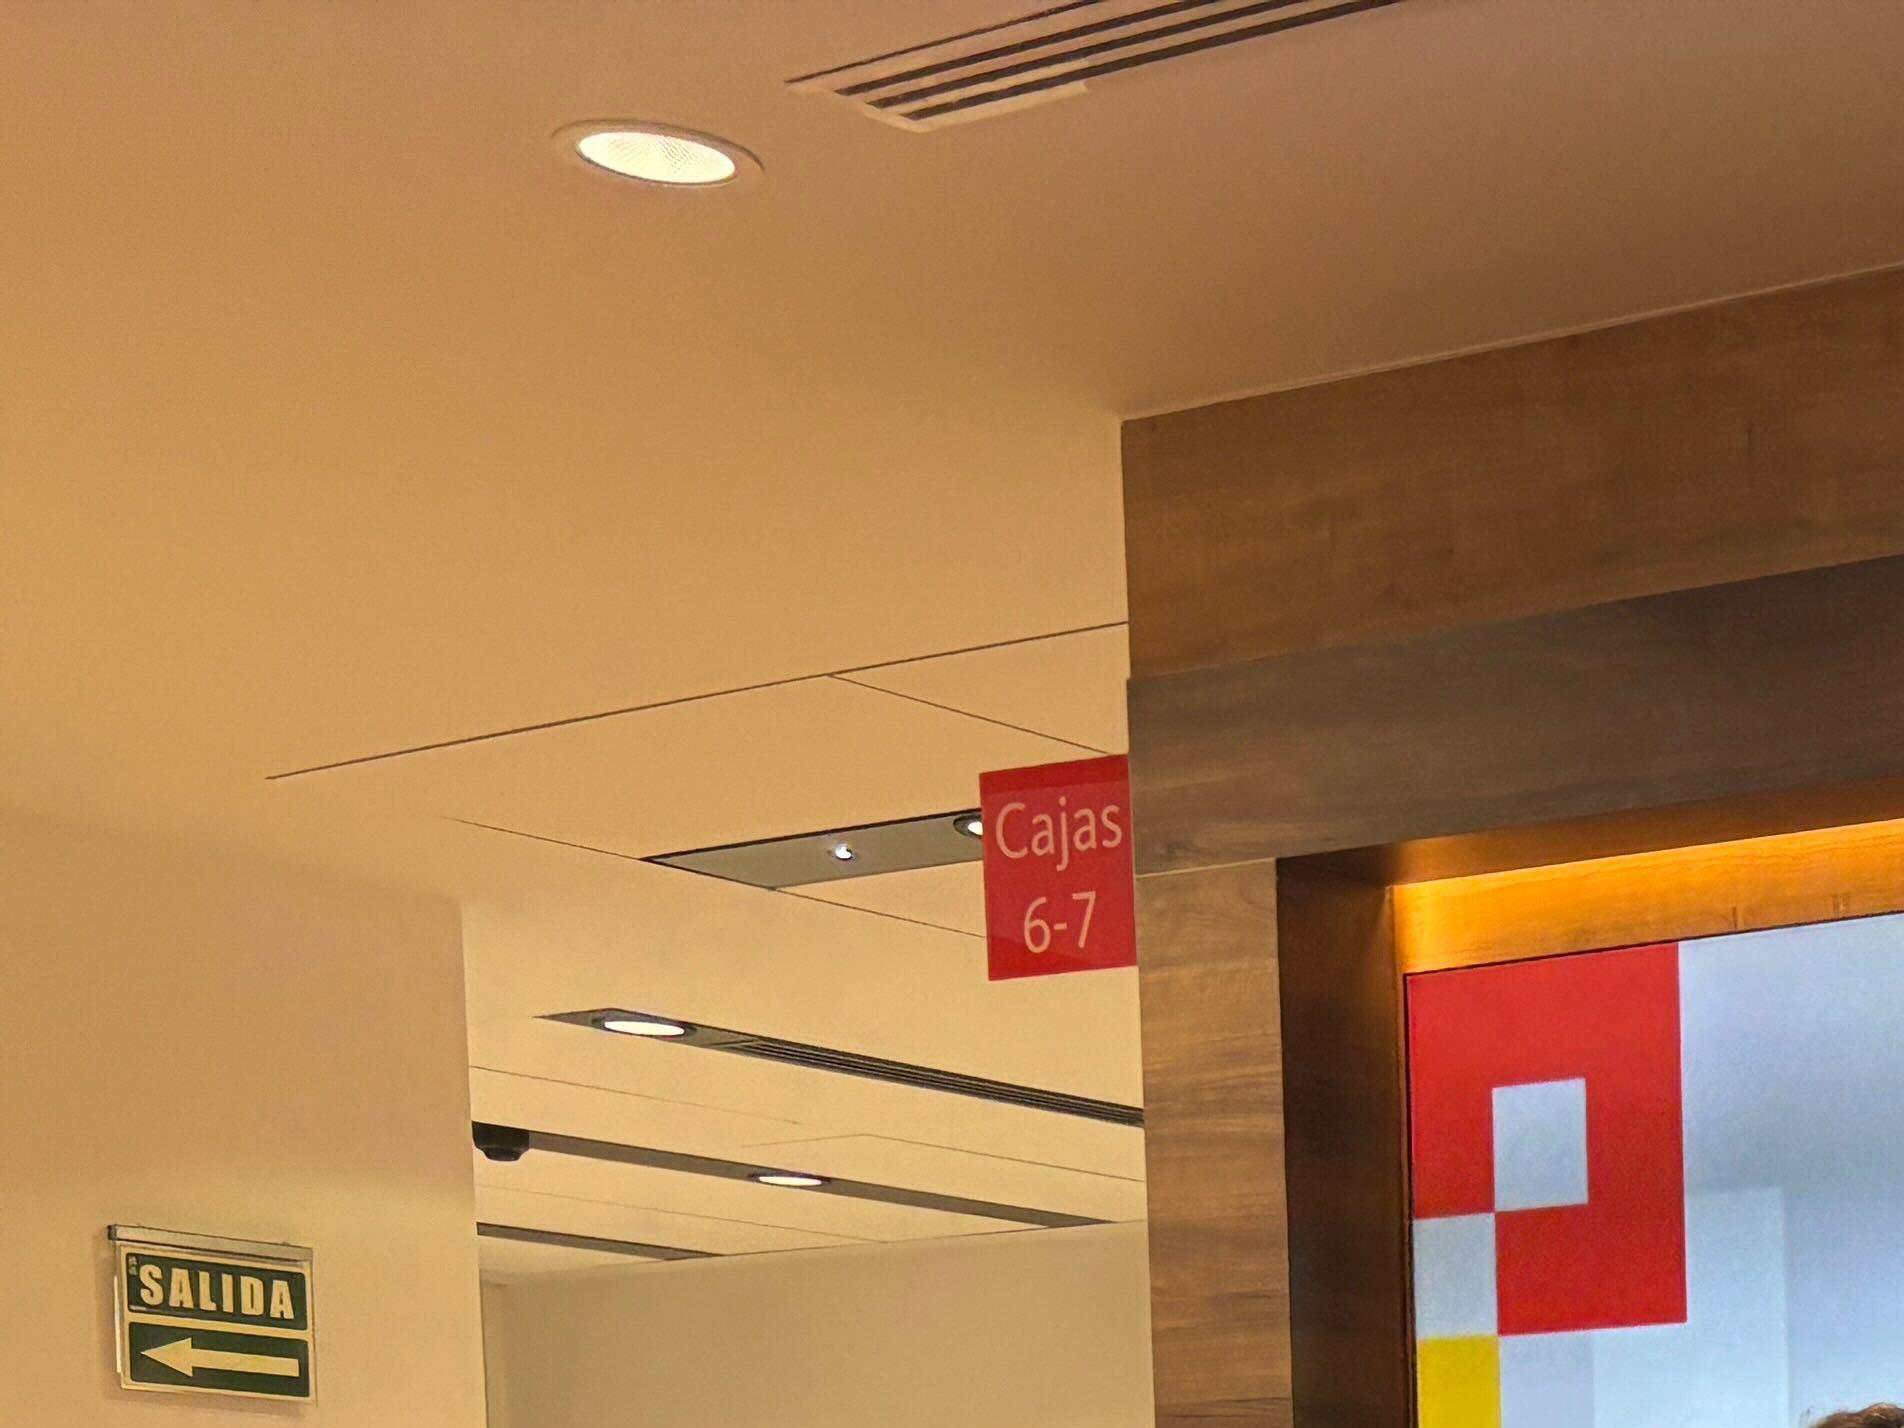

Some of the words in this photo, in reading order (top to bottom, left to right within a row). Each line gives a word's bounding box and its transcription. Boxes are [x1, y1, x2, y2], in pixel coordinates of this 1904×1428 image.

[996, 796, 1122, 872] Cajas
[1024, 891, 1096, 954] 6-7
[139, 1264, 294, 1319] SALIDA
